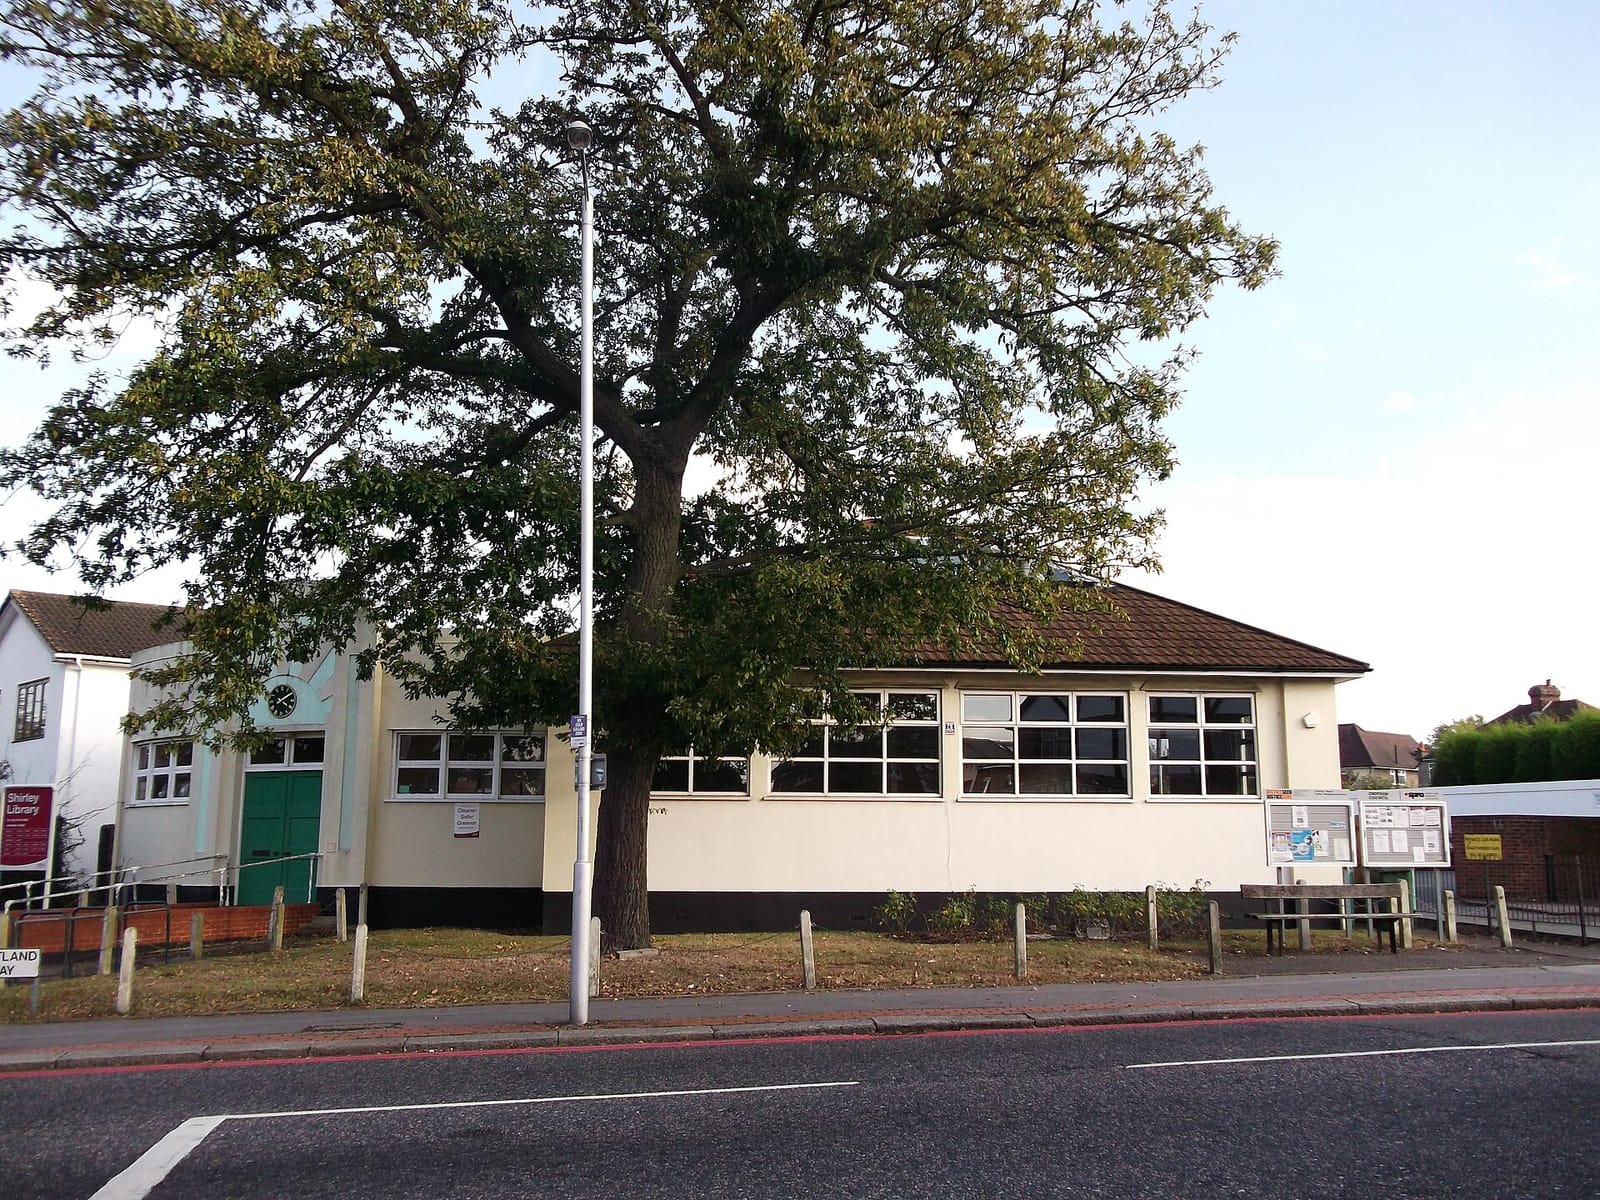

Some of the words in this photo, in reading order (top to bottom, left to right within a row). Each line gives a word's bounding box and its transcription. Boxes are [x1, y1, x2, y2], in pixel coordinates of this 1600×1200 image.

[7, 793, 39, 804] Shirley
[7, 804, 39, 816] Library
[0, 951, 37, 961] LAND
